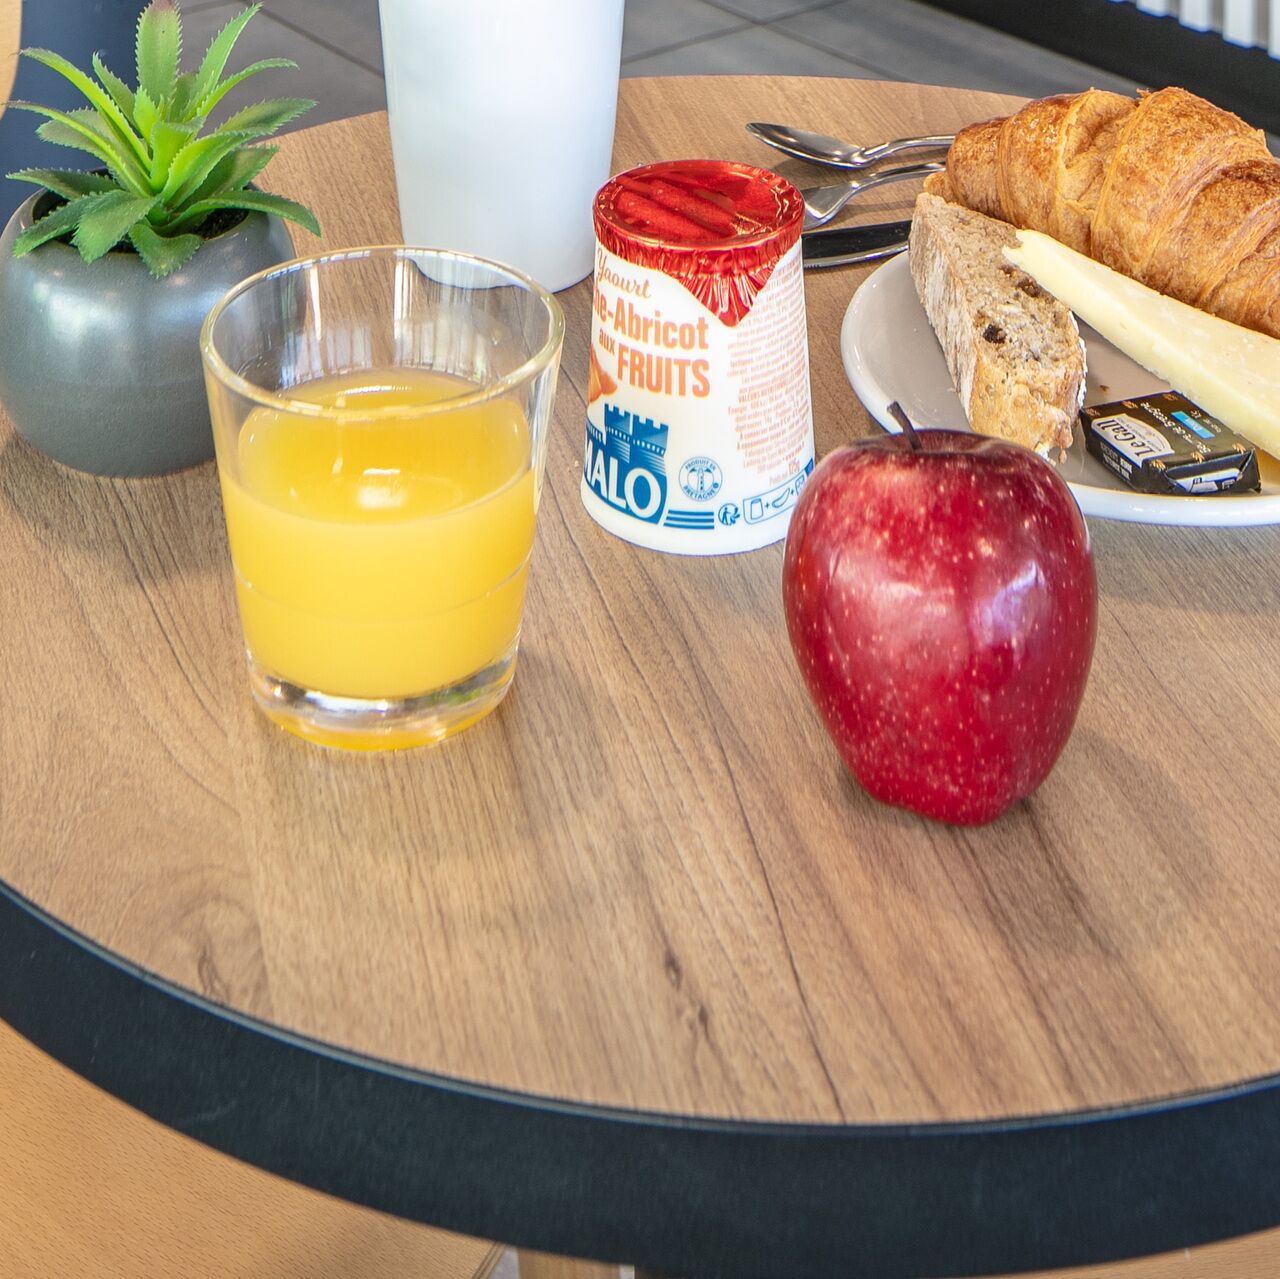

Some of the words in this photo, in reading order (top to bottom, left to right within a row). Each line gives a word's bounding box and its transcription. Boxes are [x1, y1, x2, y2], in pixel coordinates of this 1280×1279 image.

[597, 247, 651, 299] Yaourt
[599, 328, 615, 355] aux
[617, 342, 710, 398] FRUITS
[1097, 418, 1137, 441] Gall
[1131, 440, 1157, 458] Le
[685, 459, 709, 471] PRODUIT
[683, 485, 716, 500] BRETAGNE
